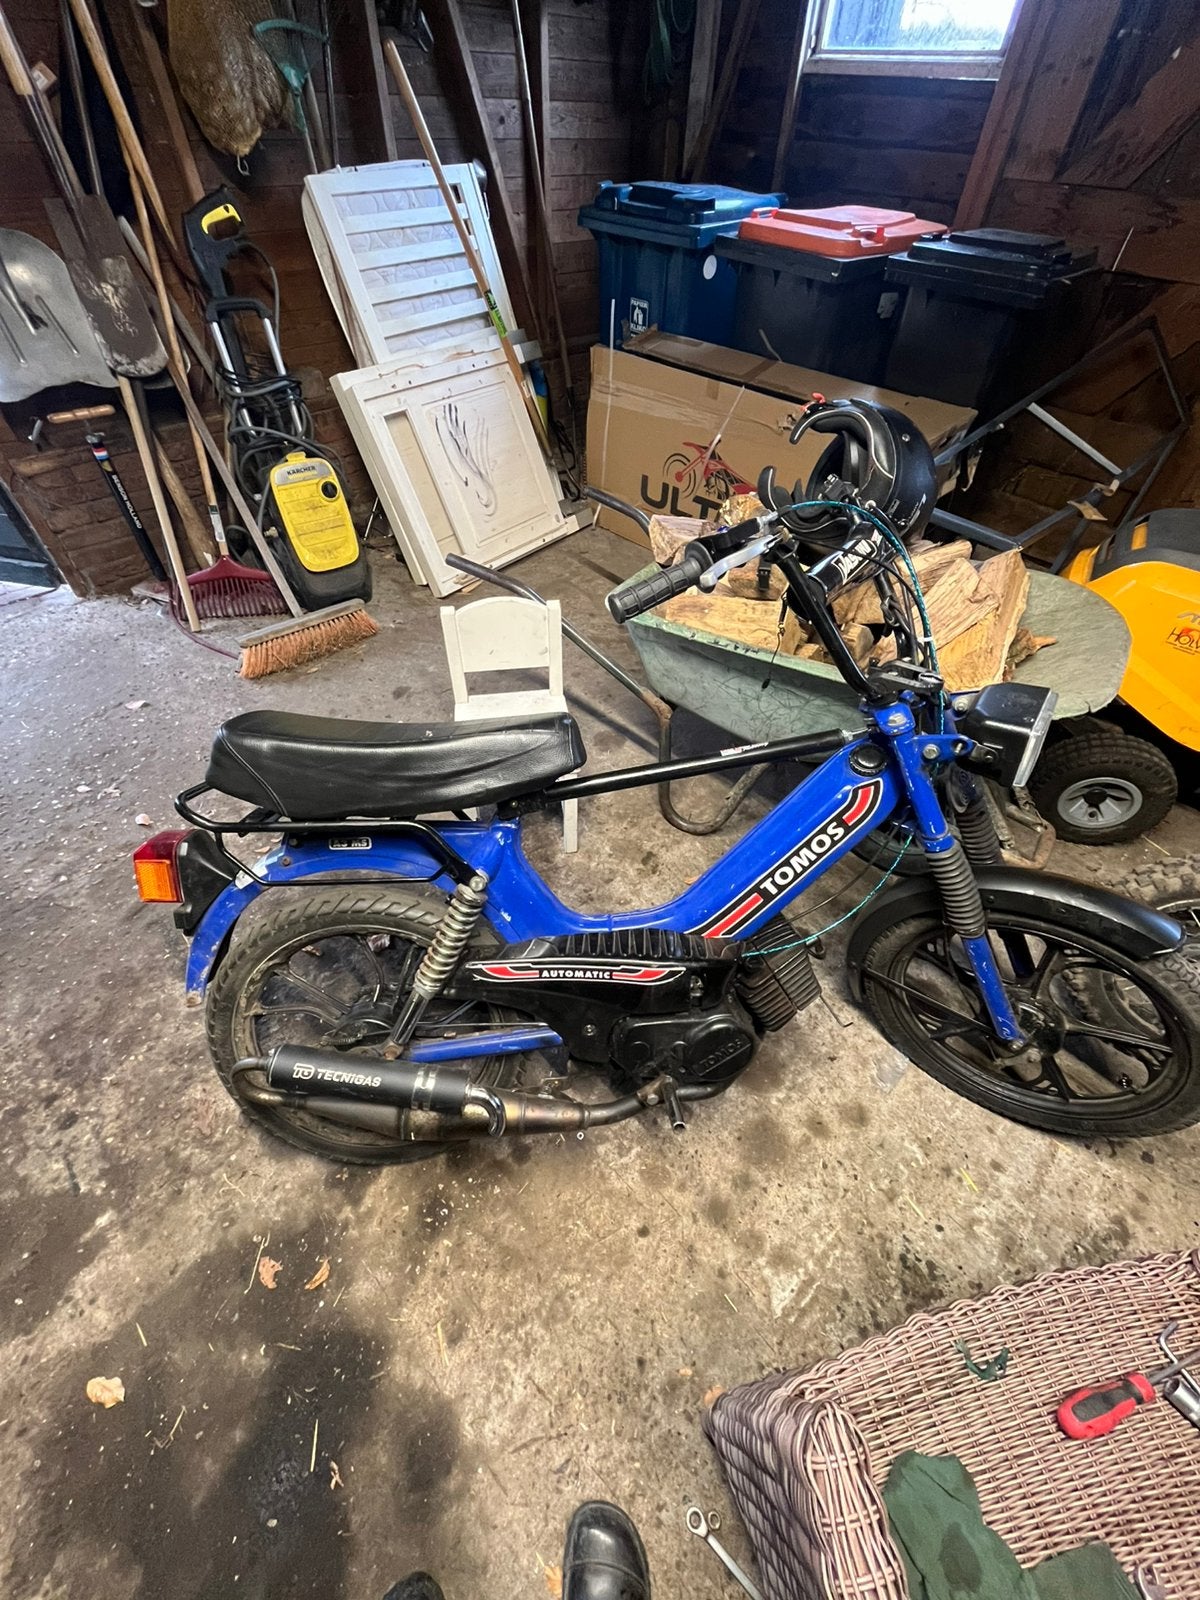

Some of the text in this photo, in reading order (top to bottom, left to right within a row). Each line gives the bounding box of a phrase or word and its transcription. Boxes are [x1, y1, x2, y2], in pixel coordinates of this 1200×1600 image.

[640, 474, 721, 523] ULT
[125, 500, 142, 529] HOLLAND
[759, 821, 845, 895] TOMOS
[541, 969, 611, 979] AUTOMATIC
[699, 1038, 742, 1068] TOMOS
[317, 1068, 382, 1088] TECNIGAS
